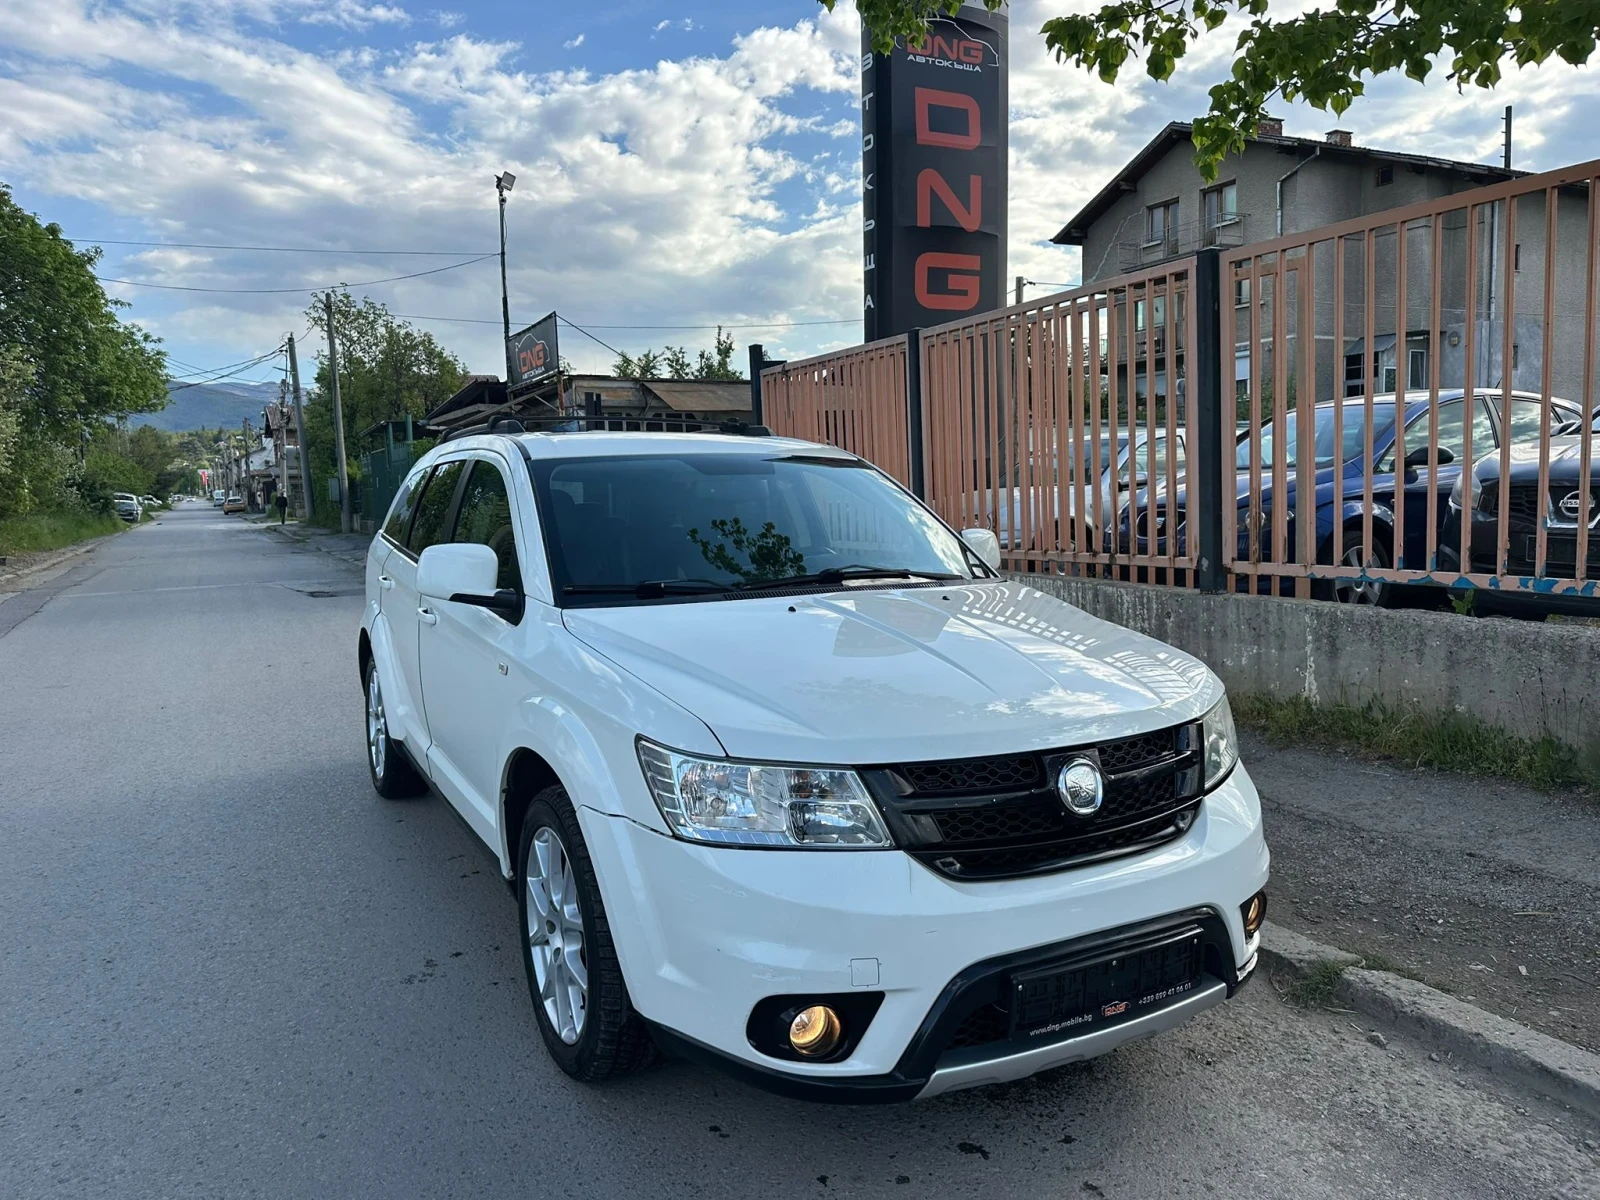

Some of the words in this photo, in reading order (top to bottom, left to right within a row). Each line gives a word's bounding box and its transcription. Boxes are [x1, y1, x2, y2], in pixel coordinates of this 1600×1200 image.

[906, 33, 983, 64] DNG
[915, 87, 982, 310] DNG
[520, 343, 545, 373] DNG
[1029, 1014, 1093, 1036] www.dng.mobile.bg
